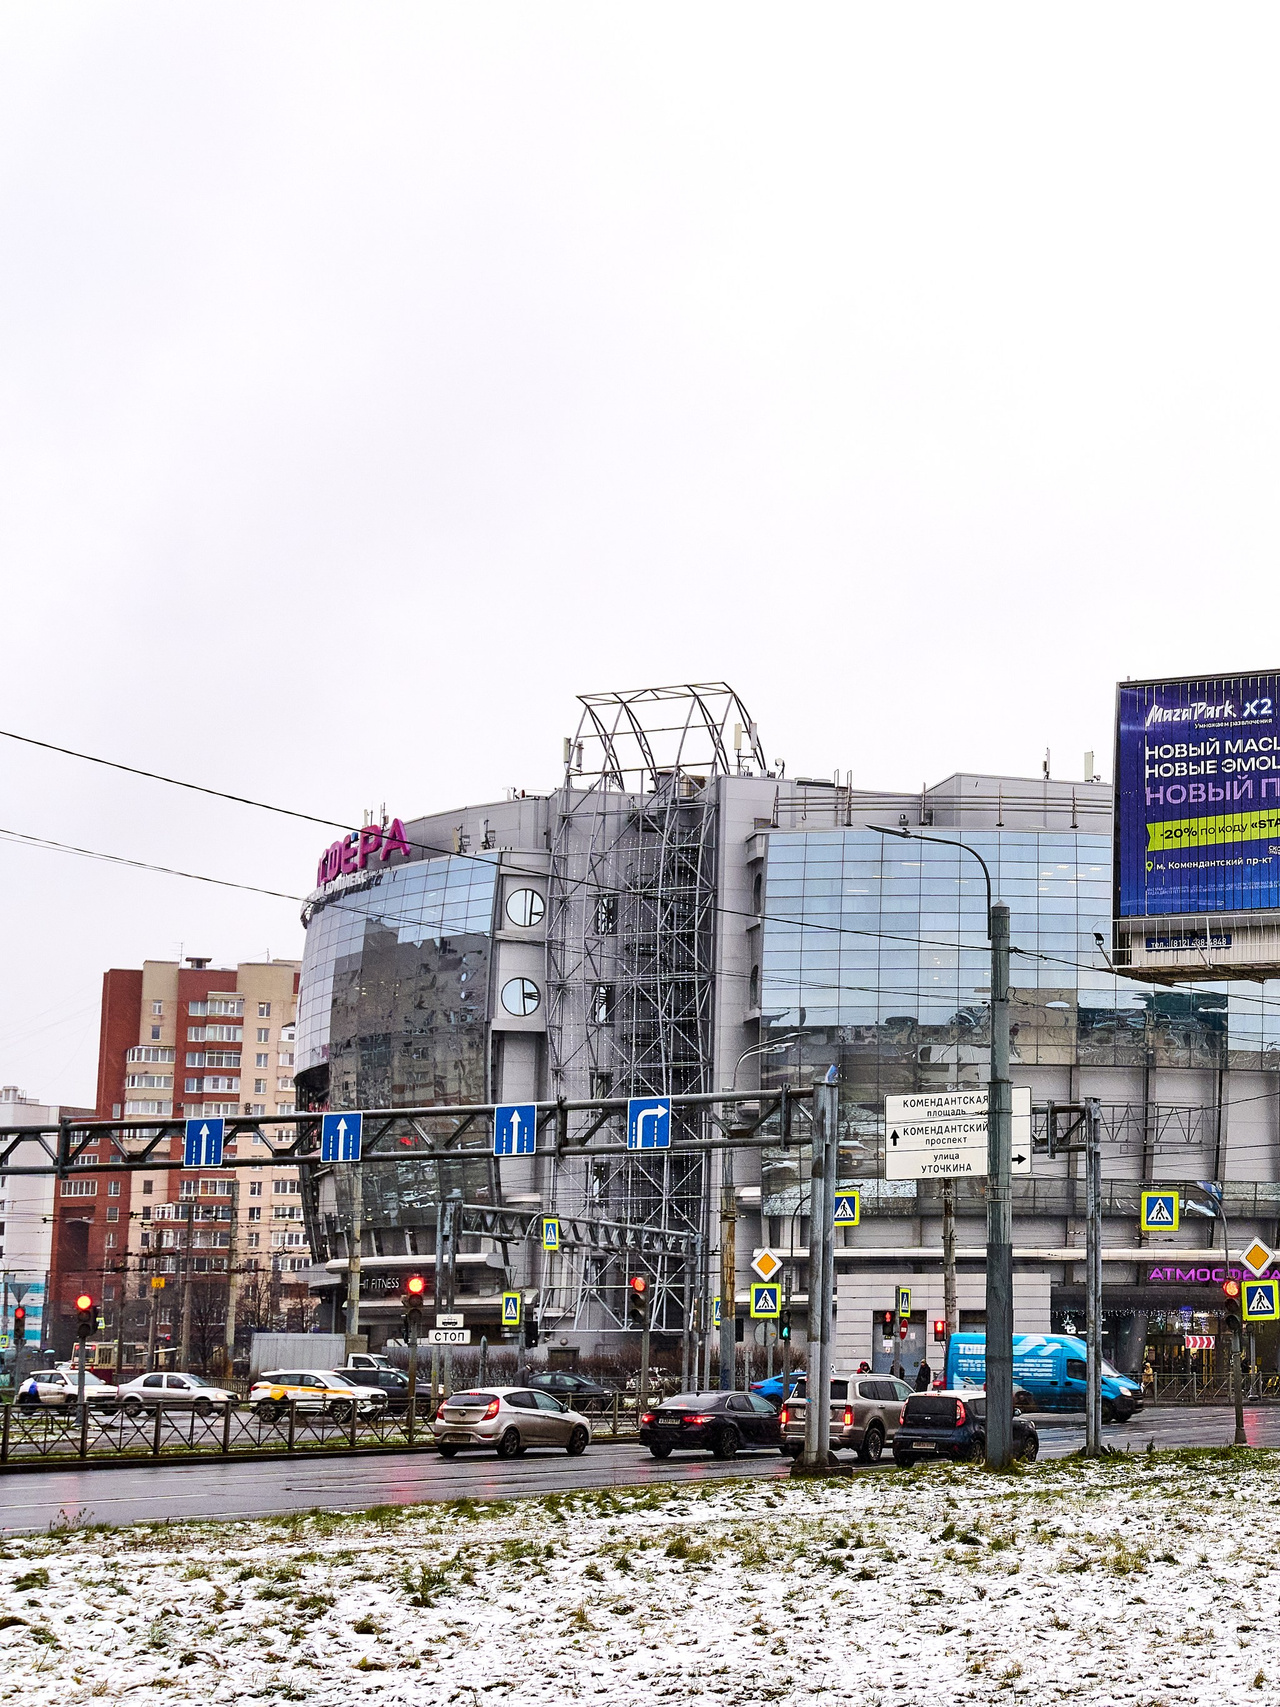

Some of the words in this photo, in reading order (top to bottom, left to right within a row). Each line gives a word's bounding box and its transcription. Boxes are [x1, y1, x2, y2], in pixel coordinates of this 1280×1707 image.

[1145, 700, 1237, 727] MazaPark
[1145, 738, 1220, 760] НОВЫЙ
[1145, 760, 1218, 779] НОВЫЕ
[1145, 775, 1253, 806] НОВЫЙ
[1159, 826, 1198, 840] -20%
[1200, 827, 1216, 837] по
[1218, 823, 1248, 833] коду
[1168, 857, 1244, 869] Комендантский
[1246, 857, 1273, 866] пр-кт
[903, 1095, 988, 1108] КОМЕНДАНТСКАЯ
[927, 1109, 966, 1118] площадь
[903, 1121, 988, 1136] КОМЕНДАНТСКИЙ
[925, 1137, 968, 1147] проспект
[933, 1152, 960, 1162] улица
[921, 1163, 972, 1174] УТОЧКИНА
[371, 1278, 400, 1289] FITNESS
[434, 1332, 466, 1341] СТОП
